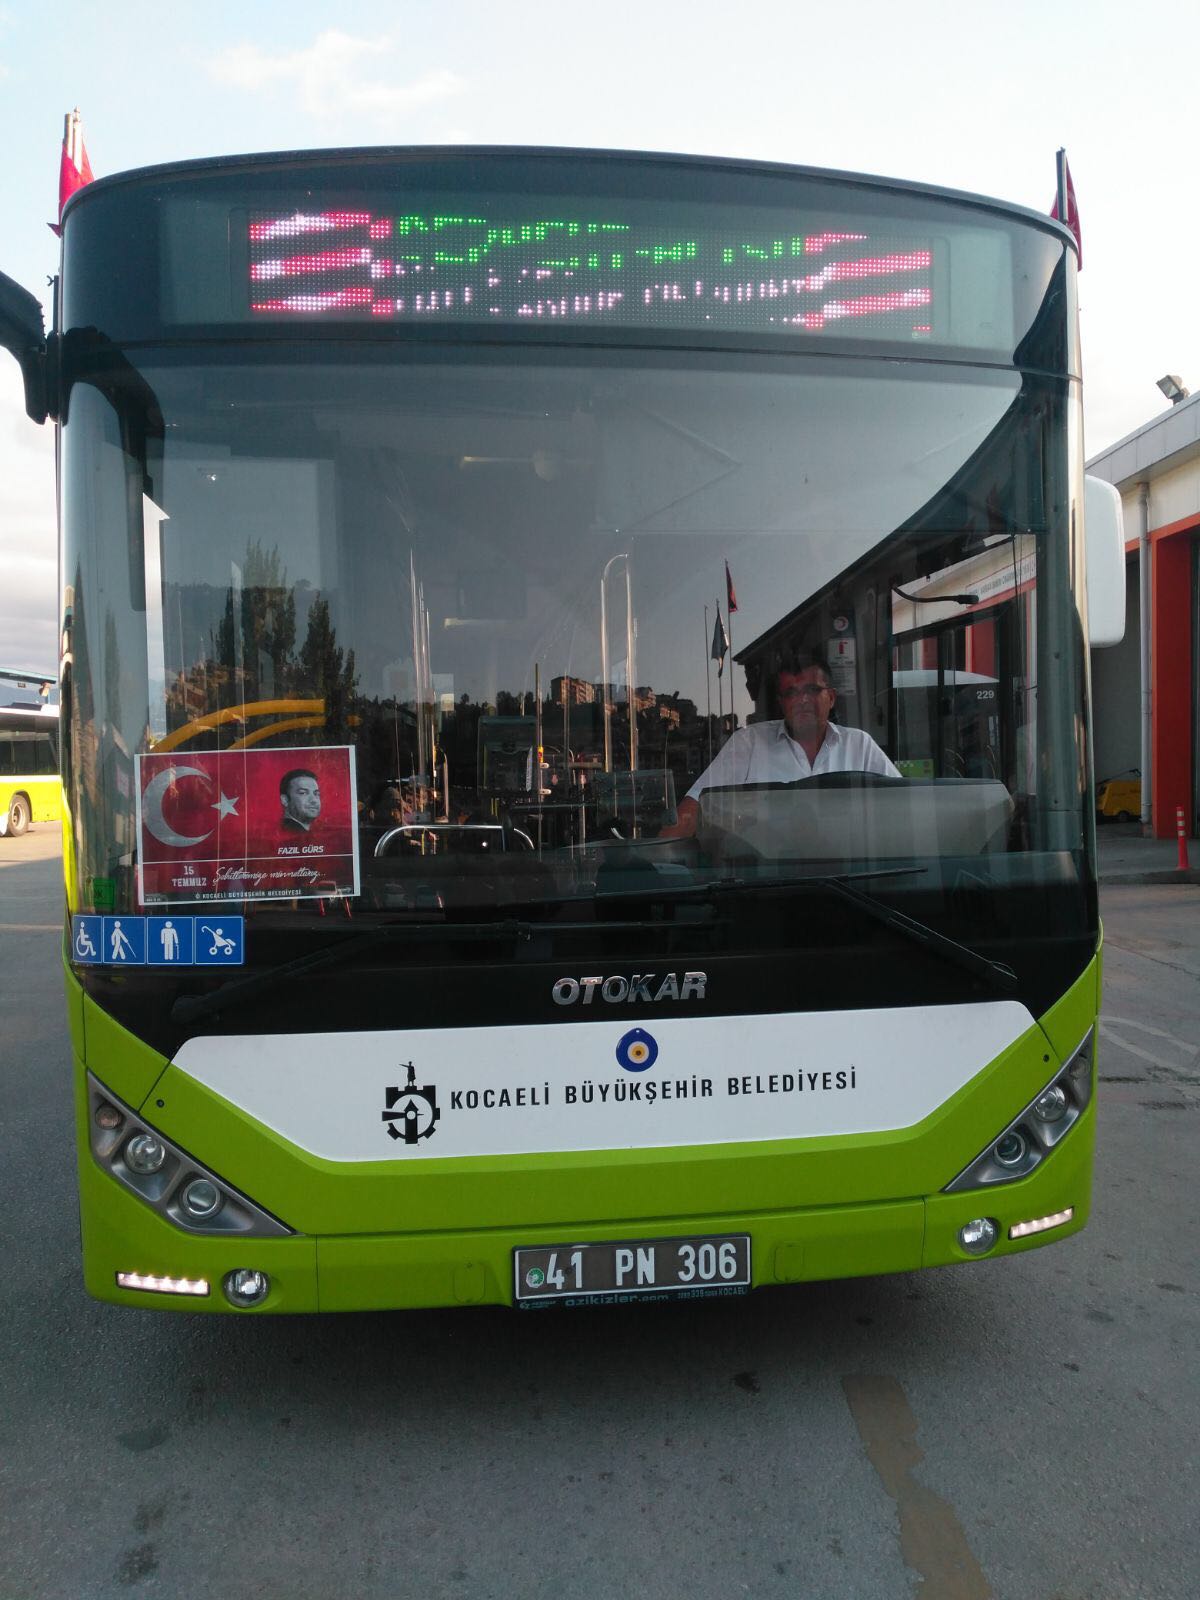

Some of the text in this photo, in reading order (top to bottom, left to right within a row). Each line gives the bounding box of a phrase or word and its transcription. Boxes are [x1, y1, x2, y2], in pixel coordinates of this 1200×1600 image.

[976, 689, 995, 700] 229
[277, 844, 324, 855] FAZIL GÜRS
[183, 865, 194, 876] 15
[171, 877, 207, 887] TEMMUZ
[552, 971, 707, 1005] OTOKAR
[450, 1065, 857, 1110] KOCAELİ BÜYÜKŞEHİR BELEDİYESİ
[546, 1242, 737, 1290] 41 PN 306
